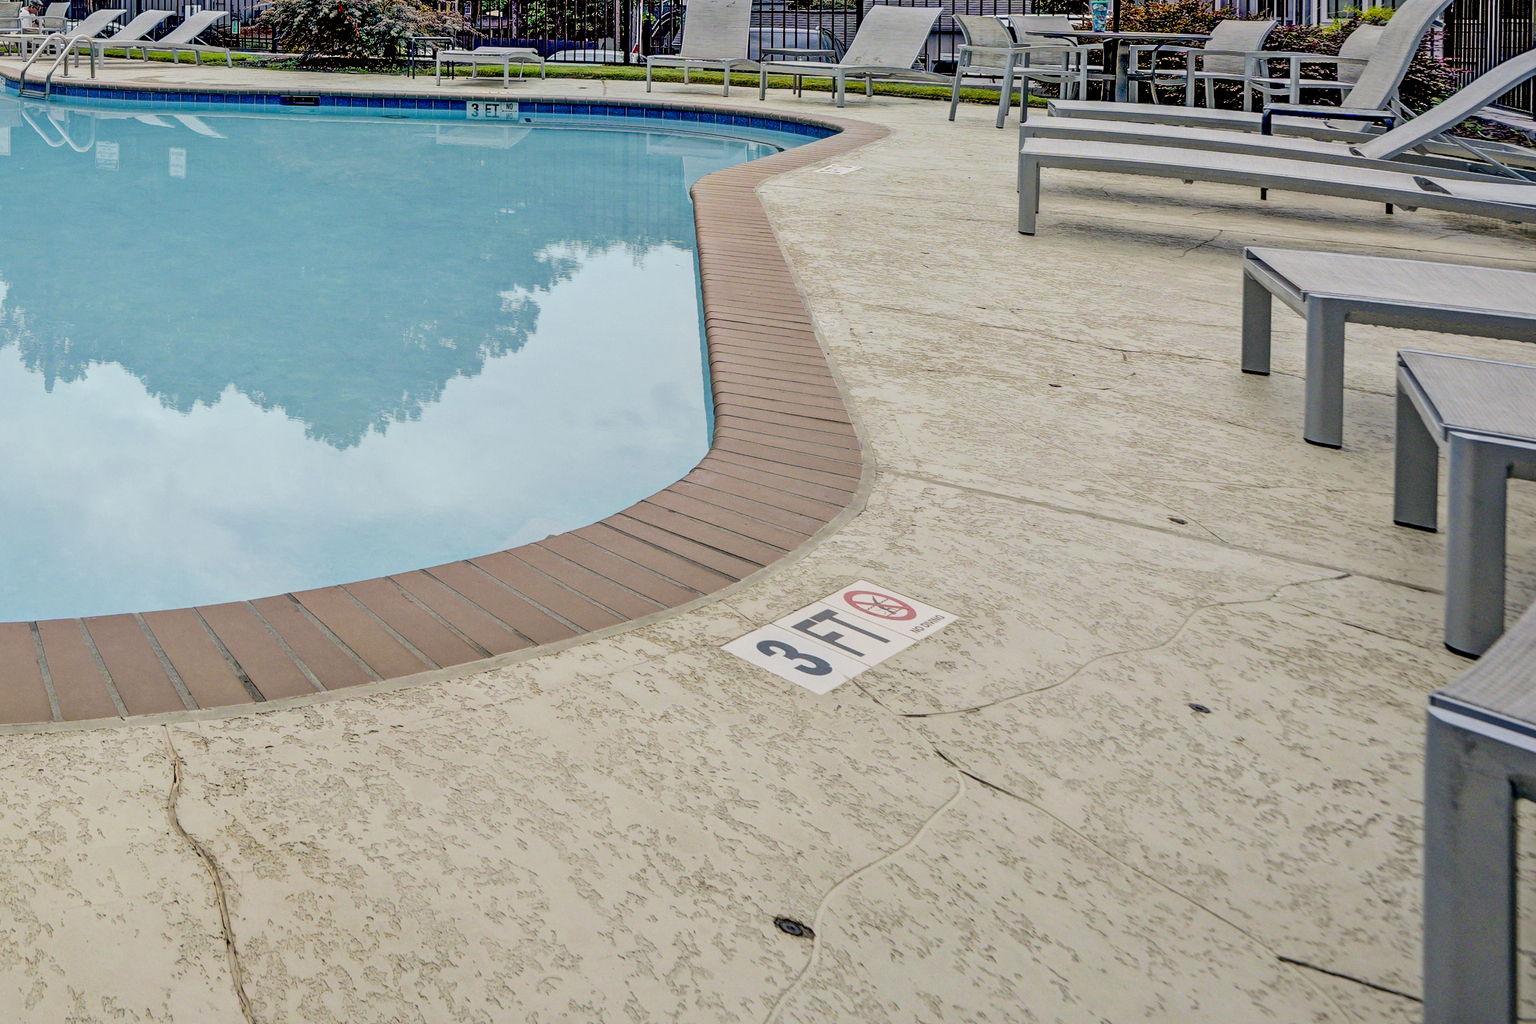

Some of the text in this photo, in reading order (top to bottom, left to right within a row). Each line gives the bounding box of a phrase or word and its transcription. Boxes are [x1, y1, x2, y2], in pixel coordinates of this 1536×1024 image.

[471, 103, 480, 115] 3
[909, 614, 946, 635] NO DIVING
[756, 608, 891, 677] 3 FT
